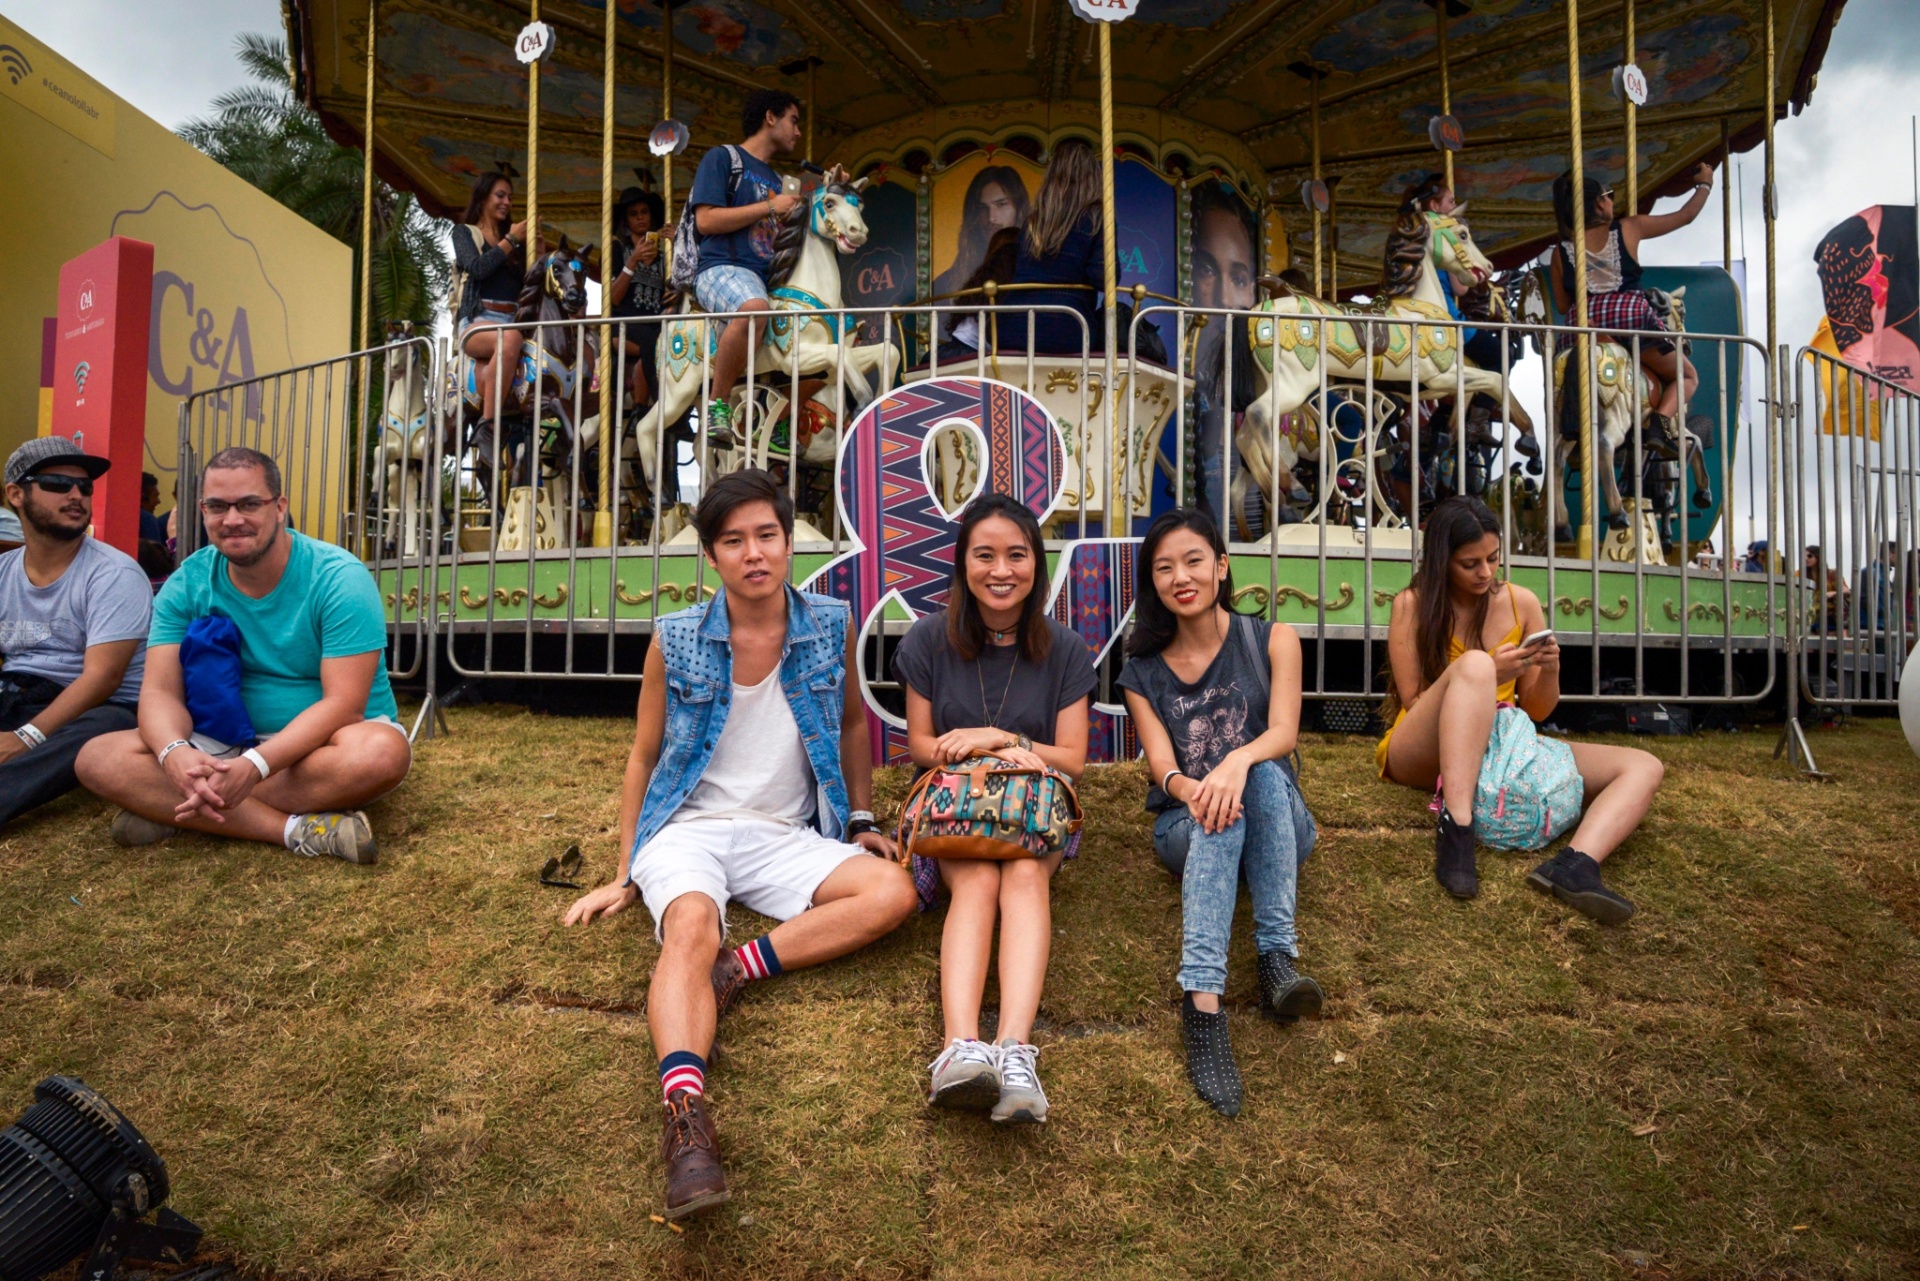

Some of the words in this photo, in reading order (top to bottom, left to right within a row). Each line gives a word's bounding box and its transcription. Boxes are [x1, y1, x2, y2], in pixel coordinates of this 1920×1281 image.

[520, 31, 543, 54] C&A
[1118, 246, 1149, 274] &A
[858, 263, 895, 294] C&A
[148, 270, 265, 424] C&A
